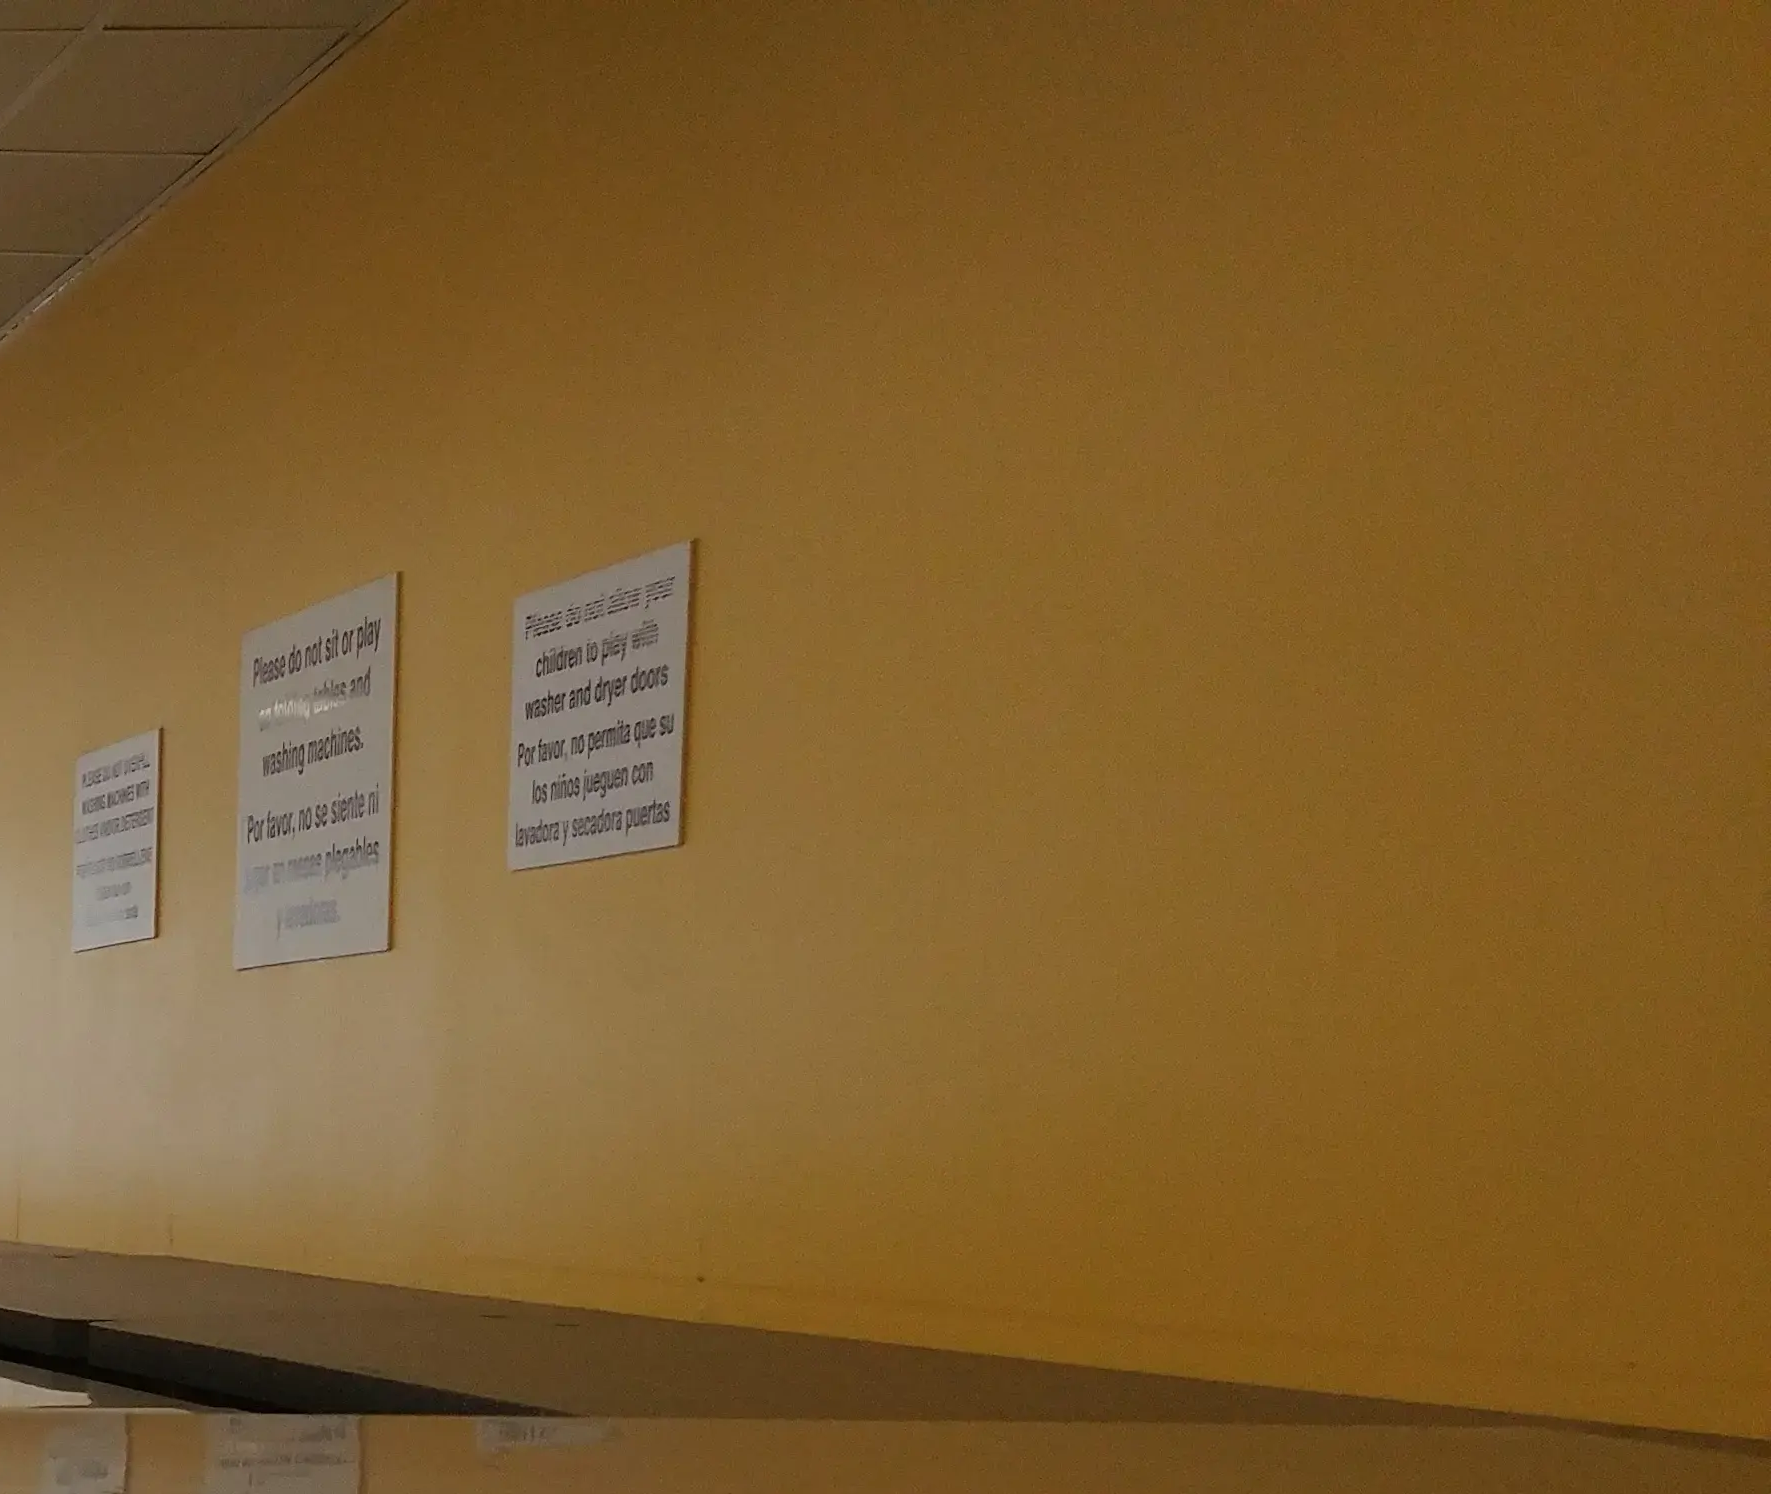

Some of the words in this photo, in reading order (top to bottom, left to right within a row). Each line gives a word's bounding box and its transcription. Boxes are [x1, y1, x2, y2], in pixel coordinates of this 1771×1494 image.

[525, 609, 563, 640] Please
[565, 604, 579, 627] do
[583, 594, 605, 622] not
[607, 587, 643, 614] allow
[645, 575, 675, 610] your
[252, 653, 286, 688] Please
[287, 643, 303, 674] do
[304, 636, 323, 667] not
[325, 628, 339, 660] sit
[341, 627, 354, 656] or
[356, 616, 382, 652] play
[535, 644, 582, 678] children
[586, 638, 599, 664] to
[601, 629, 628, 667] play
[630, 617, 660, 650] with
[313, 682, 348, 718] tables
[348, 665, 372, 701] and
[525, 686, 566, 720] washer
[568, 678, 591, 708] and
[594, 672, 628, 707] dryer
[630, 662, 669, 694] doors
[261, 737, 305, 777] washing
[307, 725, 365, 766] machines.
[516, 742, 537, 767] Por
[538, 737, 569, 764] favor,
[570, 732, 585, 755] no
[587, 719, 631, 760] permita
[633, 717, 657, 745] que
[659, 712, 675, 735] su
[531, 779, 548, 805] los
[550, 773, 579, 802] niños
[582, 764, 629, 802] jueguen
[631, 760, 654, 785] con
[246, 813, 264, 845] Por
[266, 809, 296, 841] favor,
[298, 804, 313, 833] no
[314, 802, 329, 828] se
[330, 791, 366, 826] siente
[367, 783, 380, 815] ni
[515, 820, 560, 848] lavadora
[561, 820, 570, 847] y
[571, 806, 623, 838] secadora
[625, 799, 671, 836] puertas
[323, 838, 381, 883] plegables
